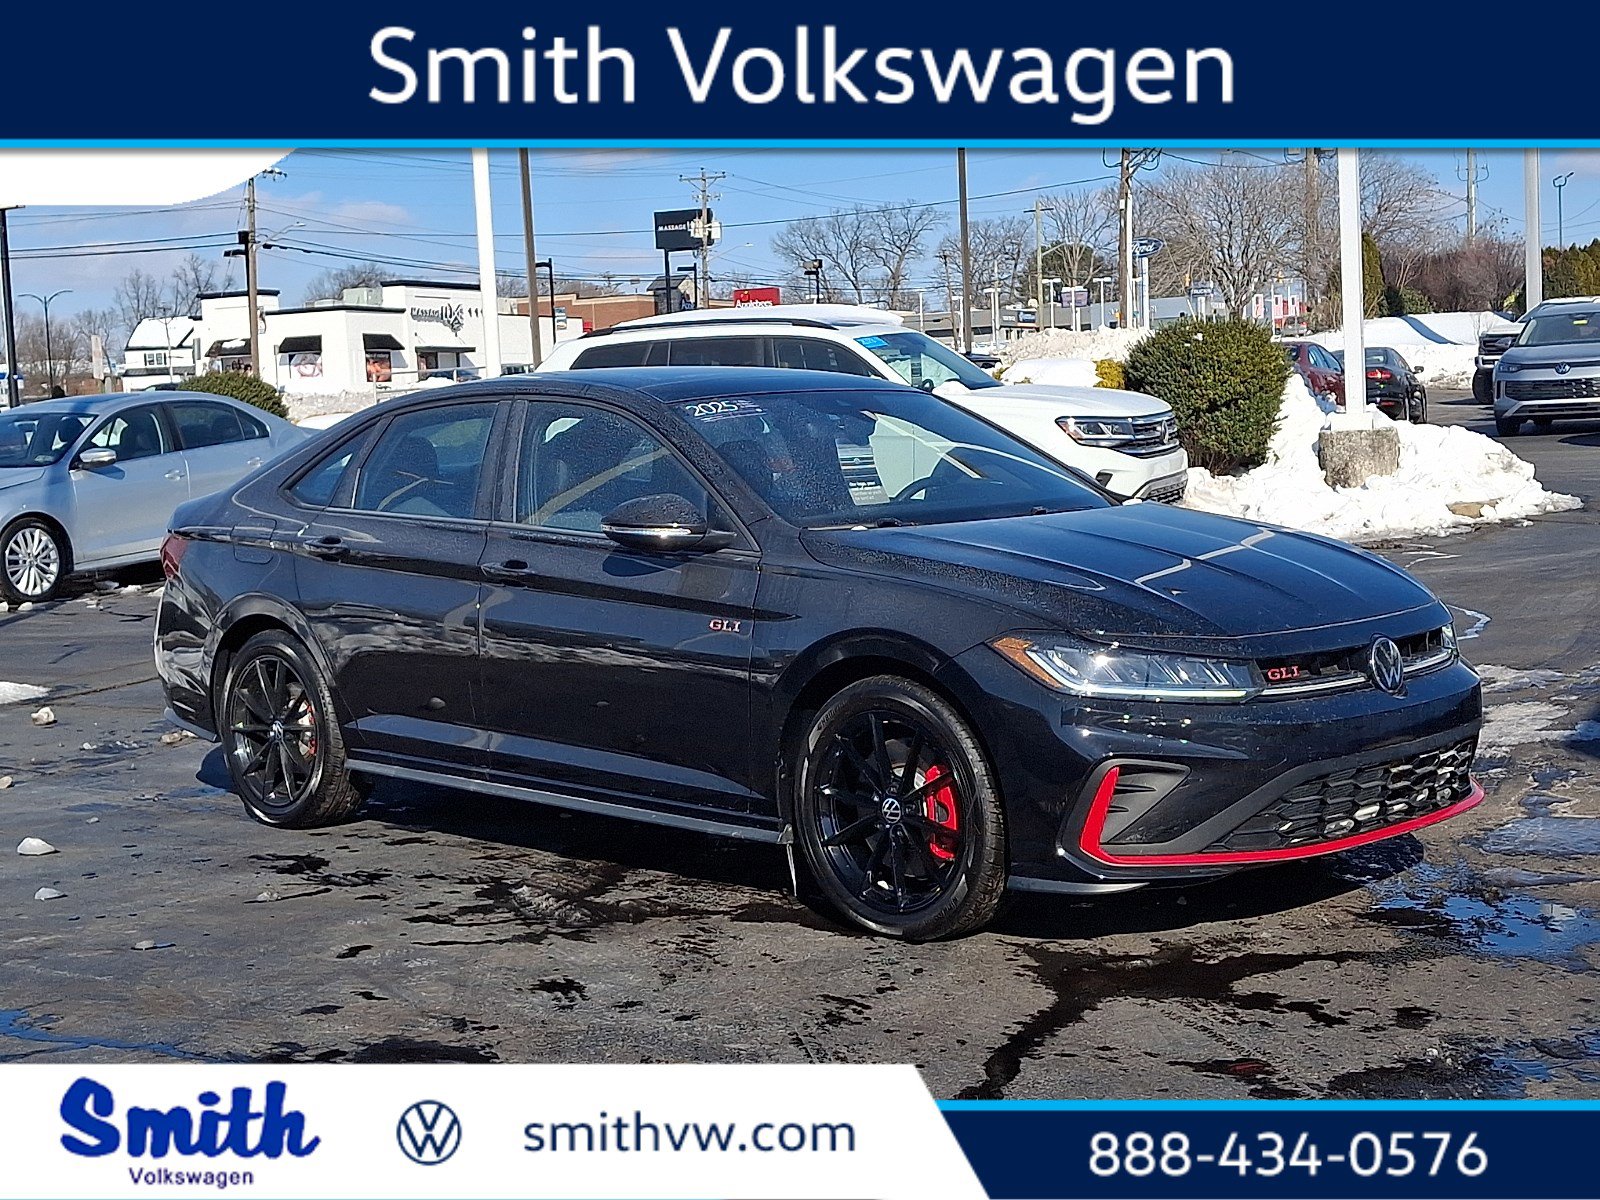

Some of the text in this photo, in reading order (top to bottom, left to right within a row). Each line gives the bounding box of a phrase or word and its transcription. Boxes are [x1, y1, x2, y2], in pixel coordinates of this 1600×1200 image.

[657, 223, 687, 231] MASSAGE
[685, 401, 738, 417] 2025
[709, 618, 741, 633] GLI
[1267, 665, 1300, 681] GLI
